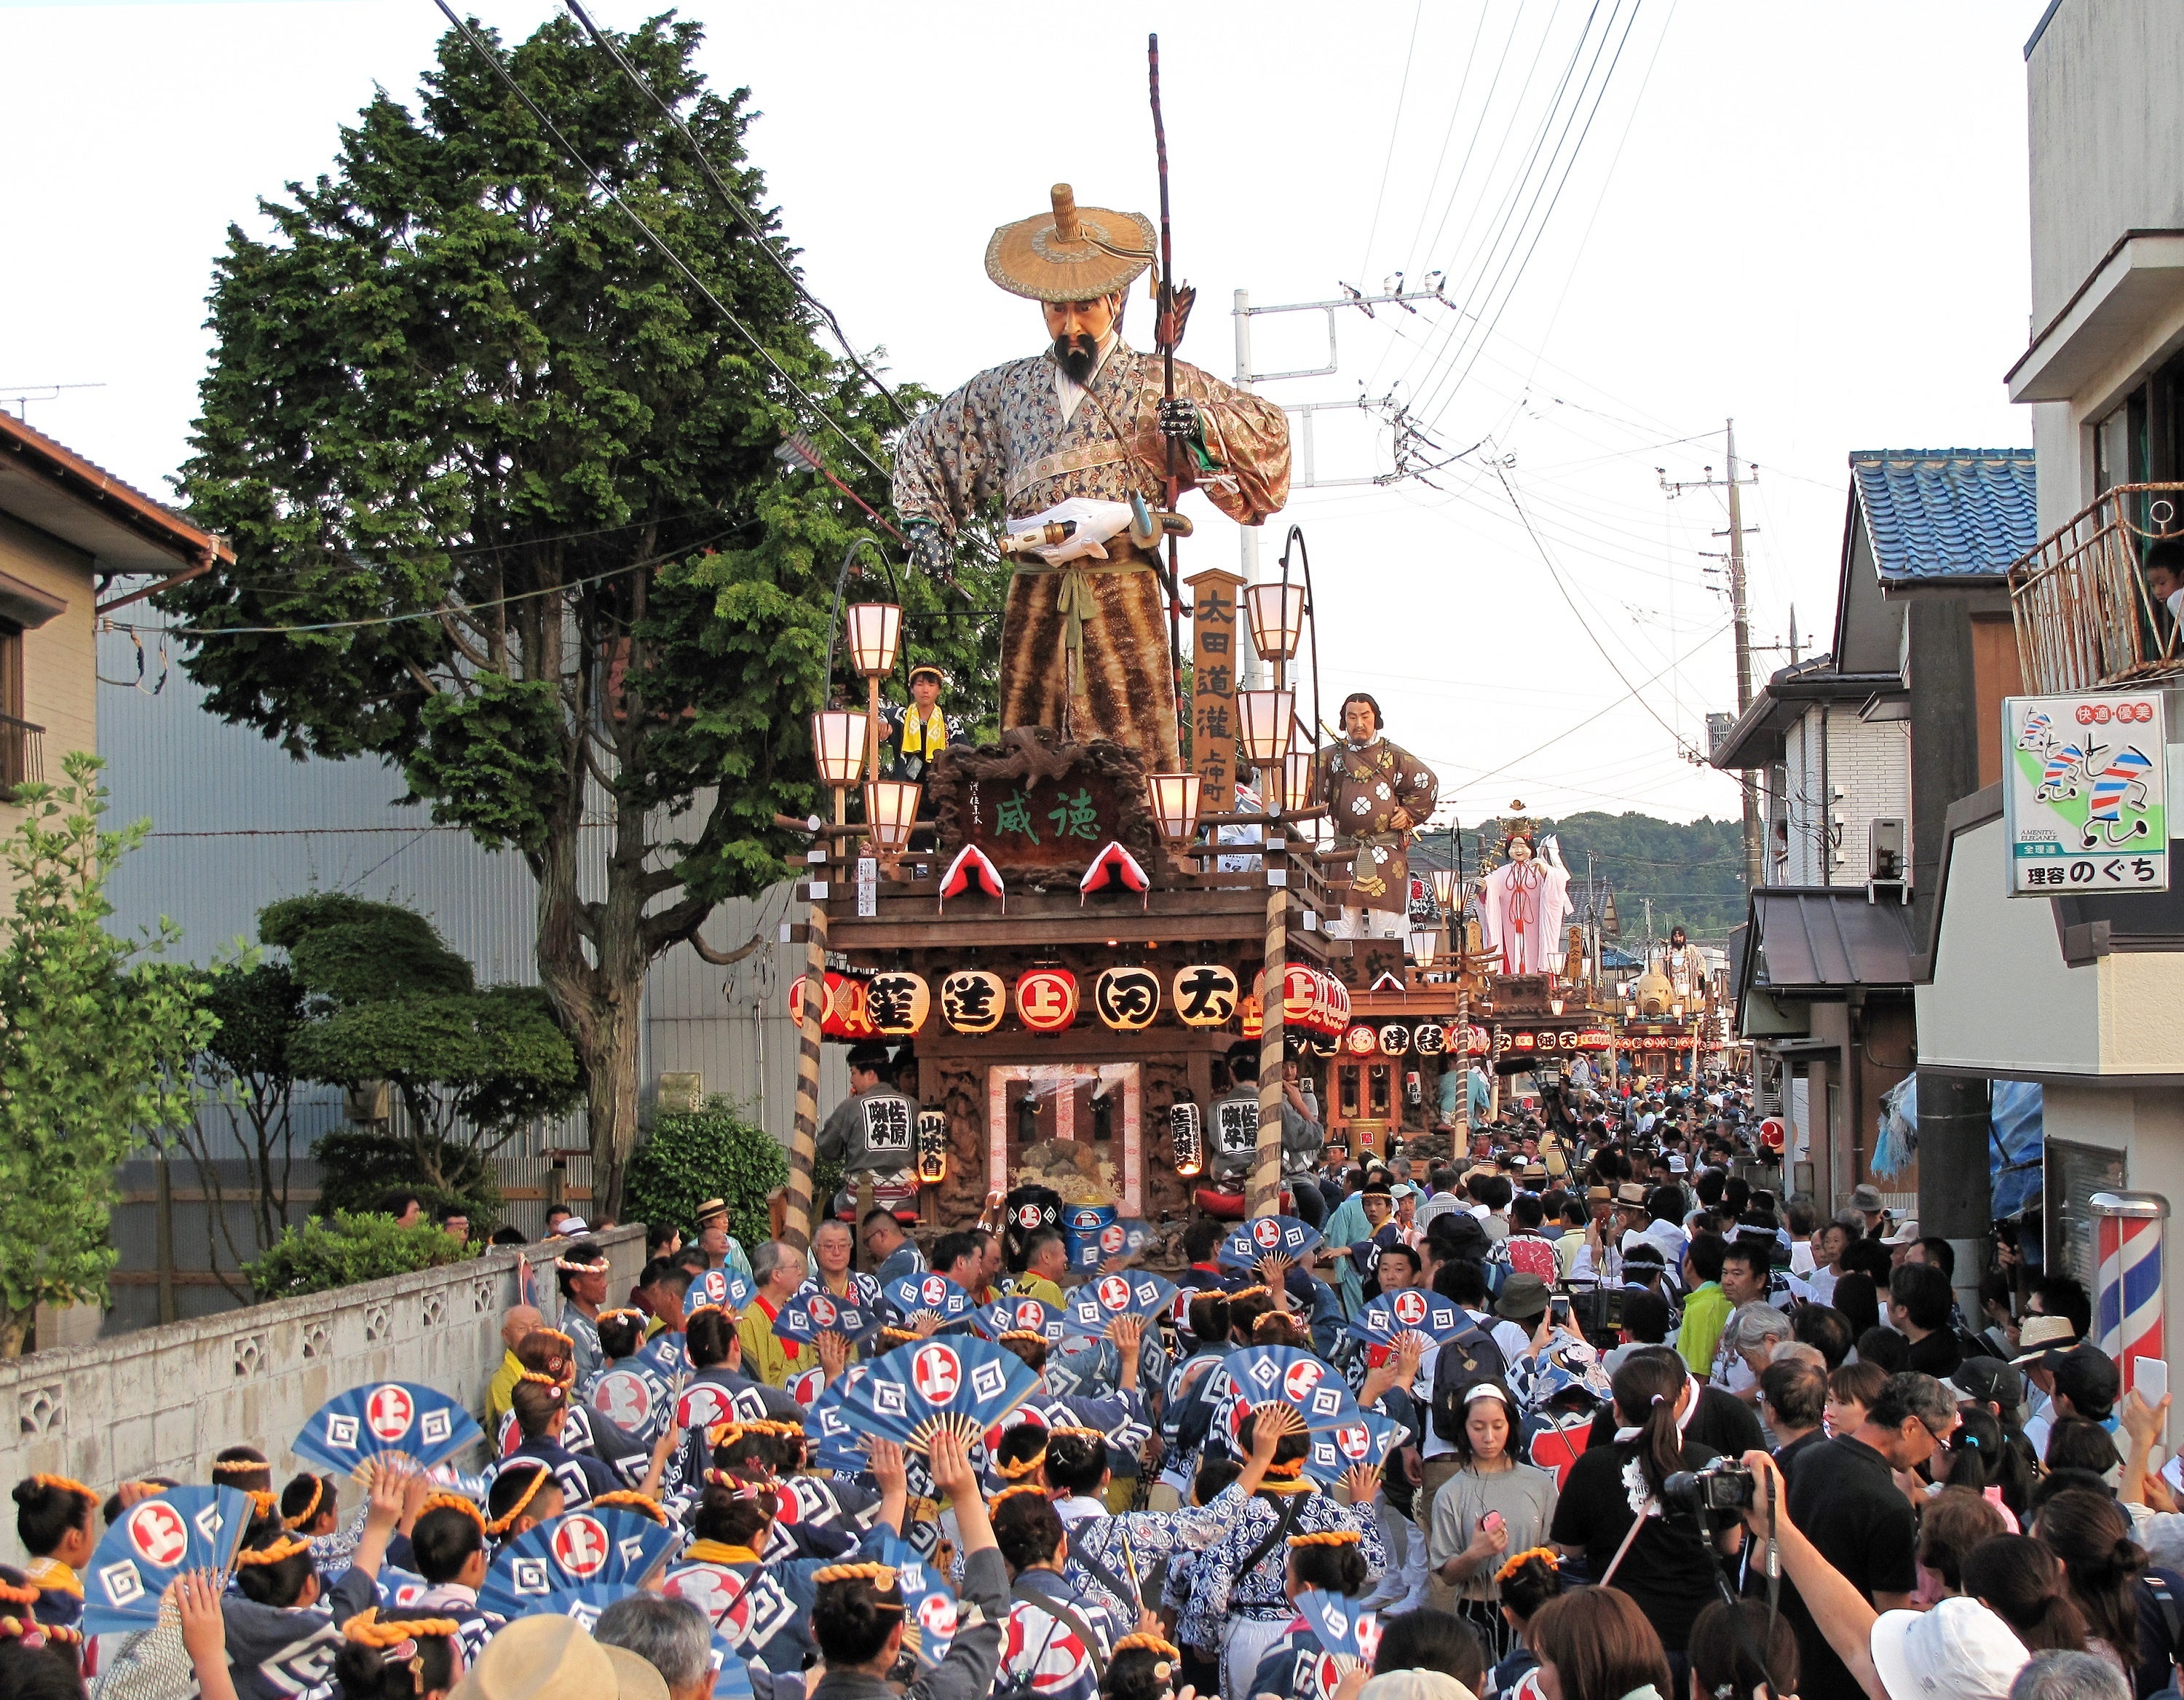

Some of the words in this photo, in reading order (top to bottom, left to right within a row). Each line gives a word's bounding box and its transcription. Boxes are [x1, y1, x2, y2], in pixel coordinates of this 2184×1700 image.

[1197, 590, 1235, 740] 太田道灌
[1198, 749, 1226, 802] 上仲町
[2024, 845, 2056, 854] 全理連
[1029, 980, 1063, 1016] 上
[1257, 1221, 1279, 1245] 上
[706, 1273, 725, 1298] 上
[926, 1278, 944, 1302] 上
[1101, 1278, 1130, 1307] 上
[812, 1297, 833, 1321] 上
[1021, 1303, 1042, 1327] 上
[1396, 1294, 1427, 1321] 上
[919, 1349, 958, 1399] 上
[1288, 1361, 1324, 1401] 上
[373, 1389, 408, 1433] 上
[603, 1377, 641, 1425] 上
[141, 1510, 186, 1563] 上
[563, 1519, 598, 1568] 上
